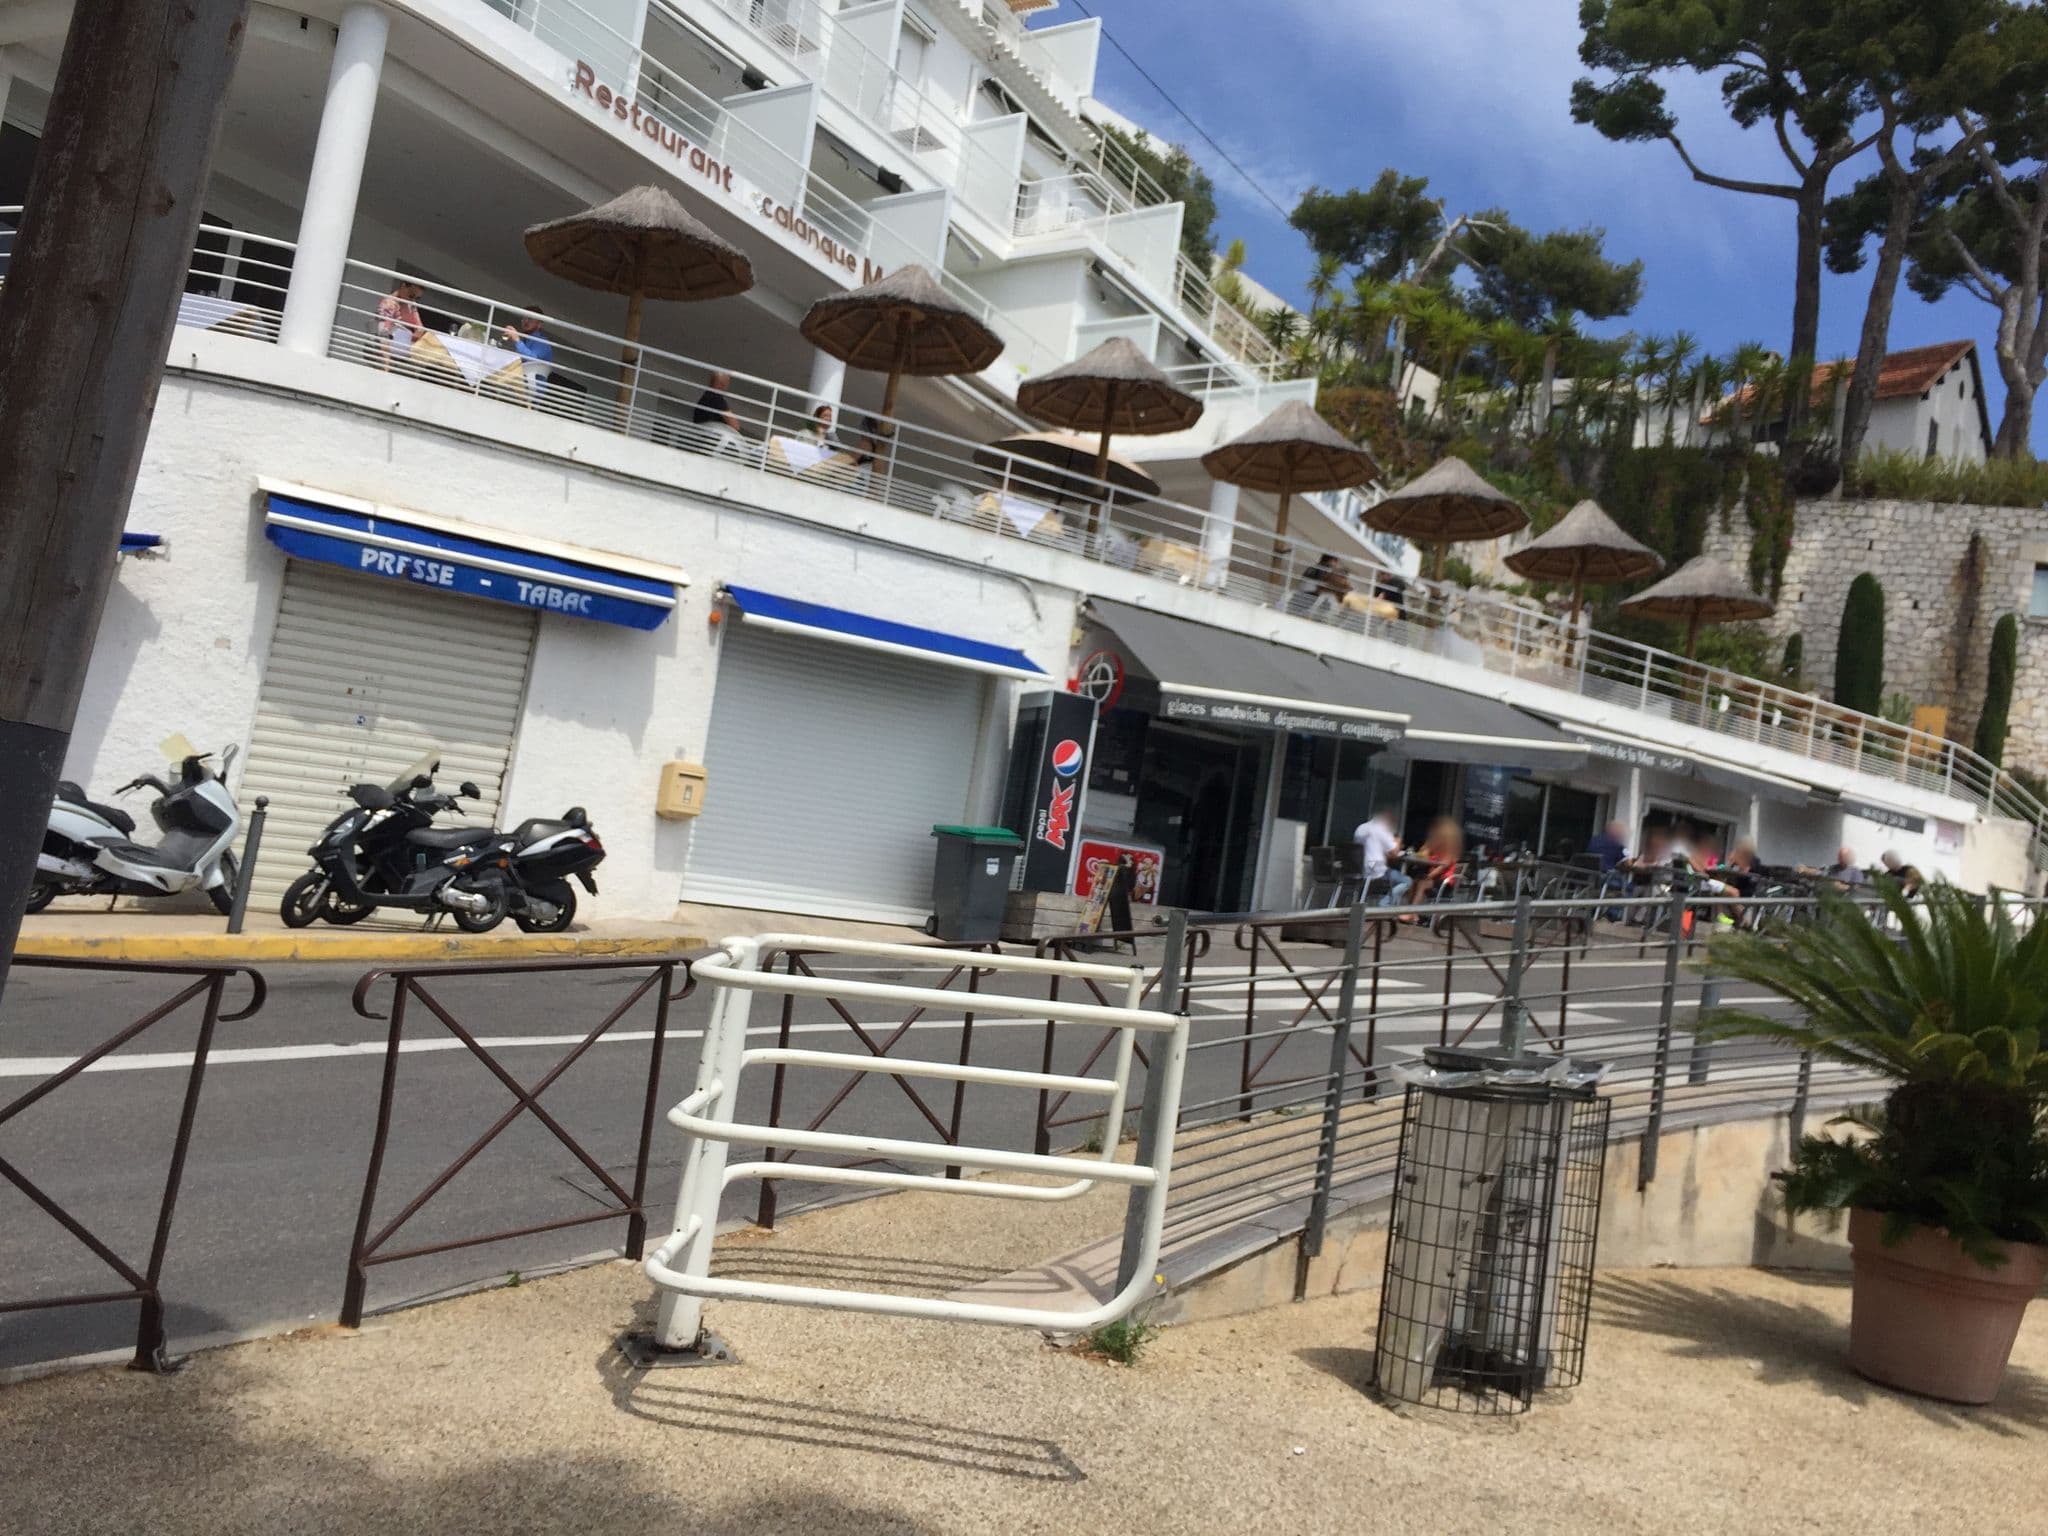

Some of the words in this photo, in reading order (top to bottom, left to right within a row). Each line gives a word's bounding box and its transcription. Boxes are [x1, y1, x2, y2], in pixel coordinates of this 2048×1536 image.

[576, 59, 732, 193] Restaurant
[518, 581, 592, 614] TABAC
[1167, 699, 1206, 716] glaces
[1036, 809, 1047, 840] pepsi
